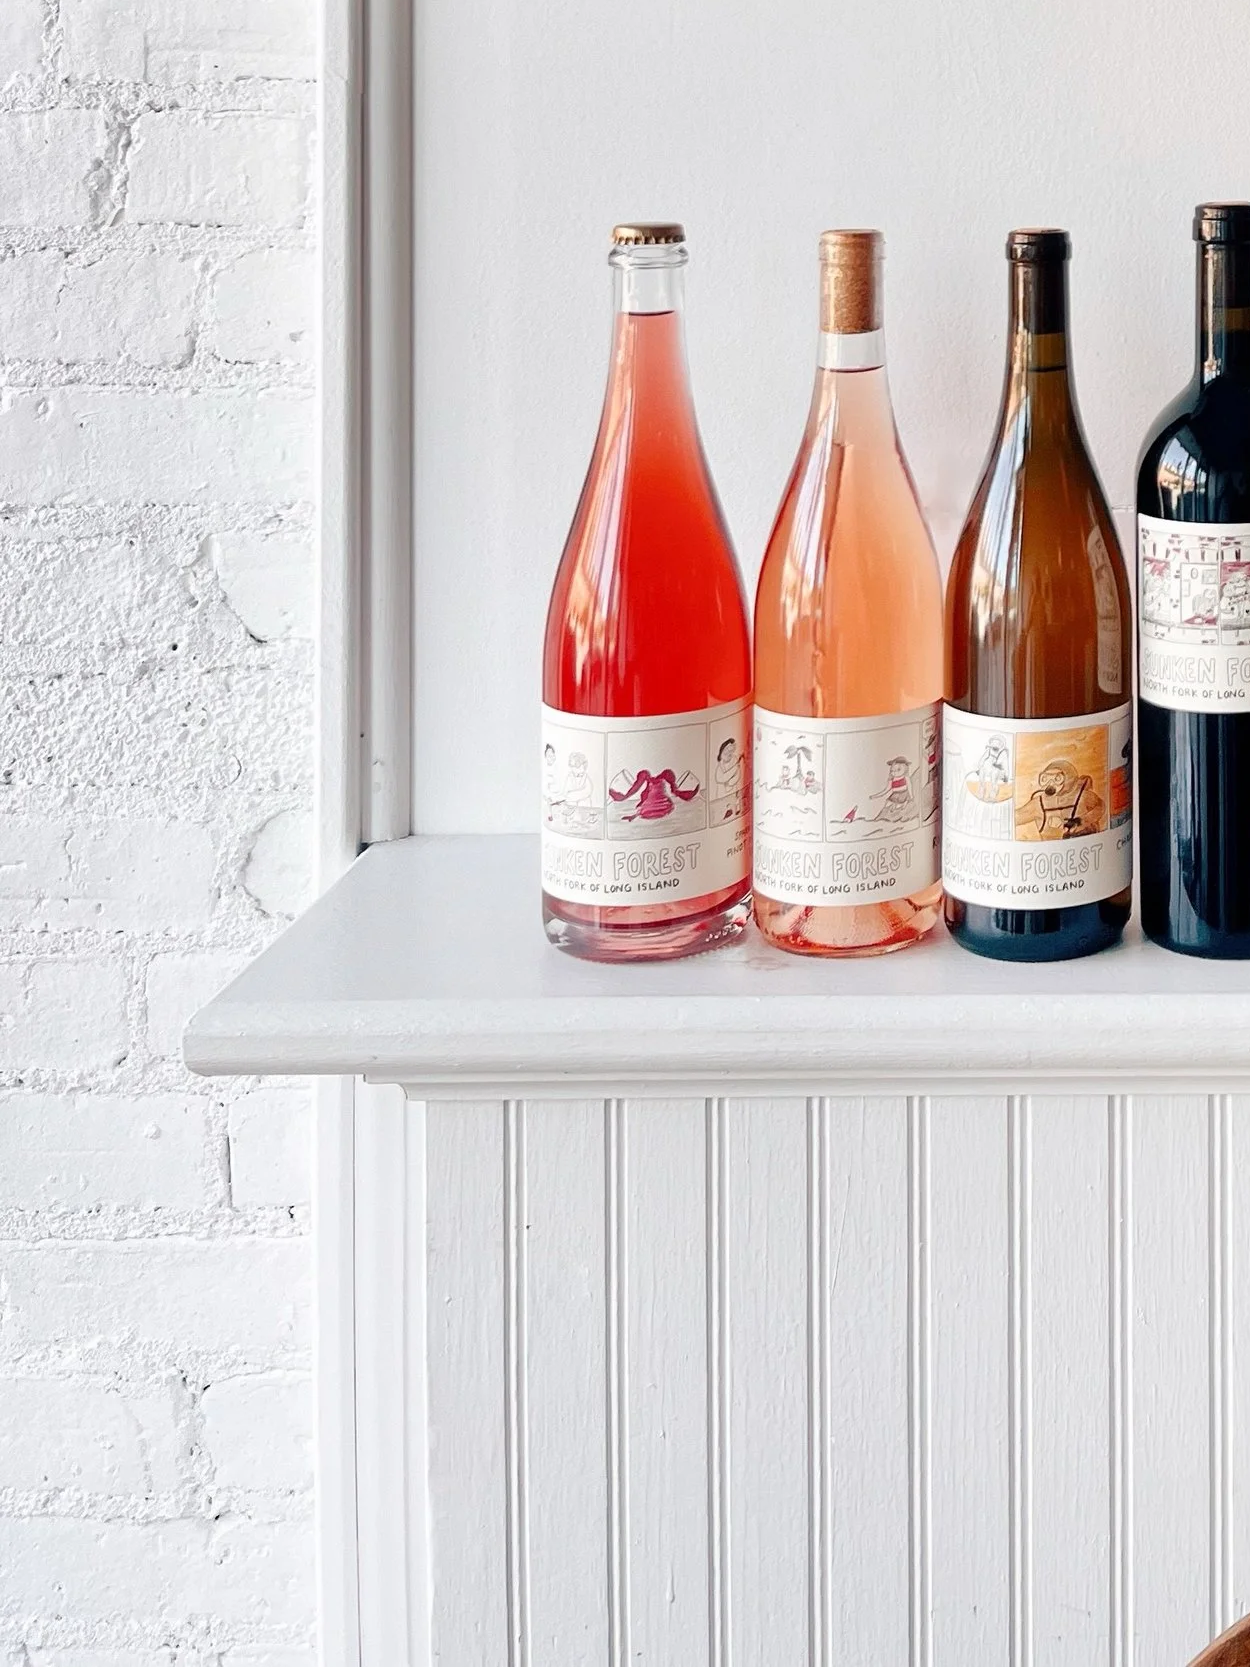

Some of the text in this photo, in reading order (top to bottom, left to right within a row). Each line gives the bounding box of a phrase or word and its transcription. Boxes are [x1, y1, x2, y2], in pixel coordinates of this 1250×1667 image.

[1172, 686, 1198, 698] FORK
[1202, 688, 1214, 699] OF
[1217, 688, 1246, 699] LONG
[543, 841, 701, 881] NKEN FOREST
[832, 842, 915, 882] FOREST
[1021, 843, 1104, 882] FOREST
[564, 878, 586, 891] FORK
[589, 883, 600, 894] OF
[603, 882, 632, 894] LONG
[637, 878, 680, 892] ISLAND
[779, 879, 803, 893] FORK
[807, 884, 819, 895] OF
[822, 883, 851, 895] LONG
[856, 877, 896, 893] ISLAND
[968, 878, 993, 891] FORK
[996, 883, 1008, 894] OF
[1011, 883, 1040, 894] LONG
[1045, 878, 1085, 893] ISLAND
